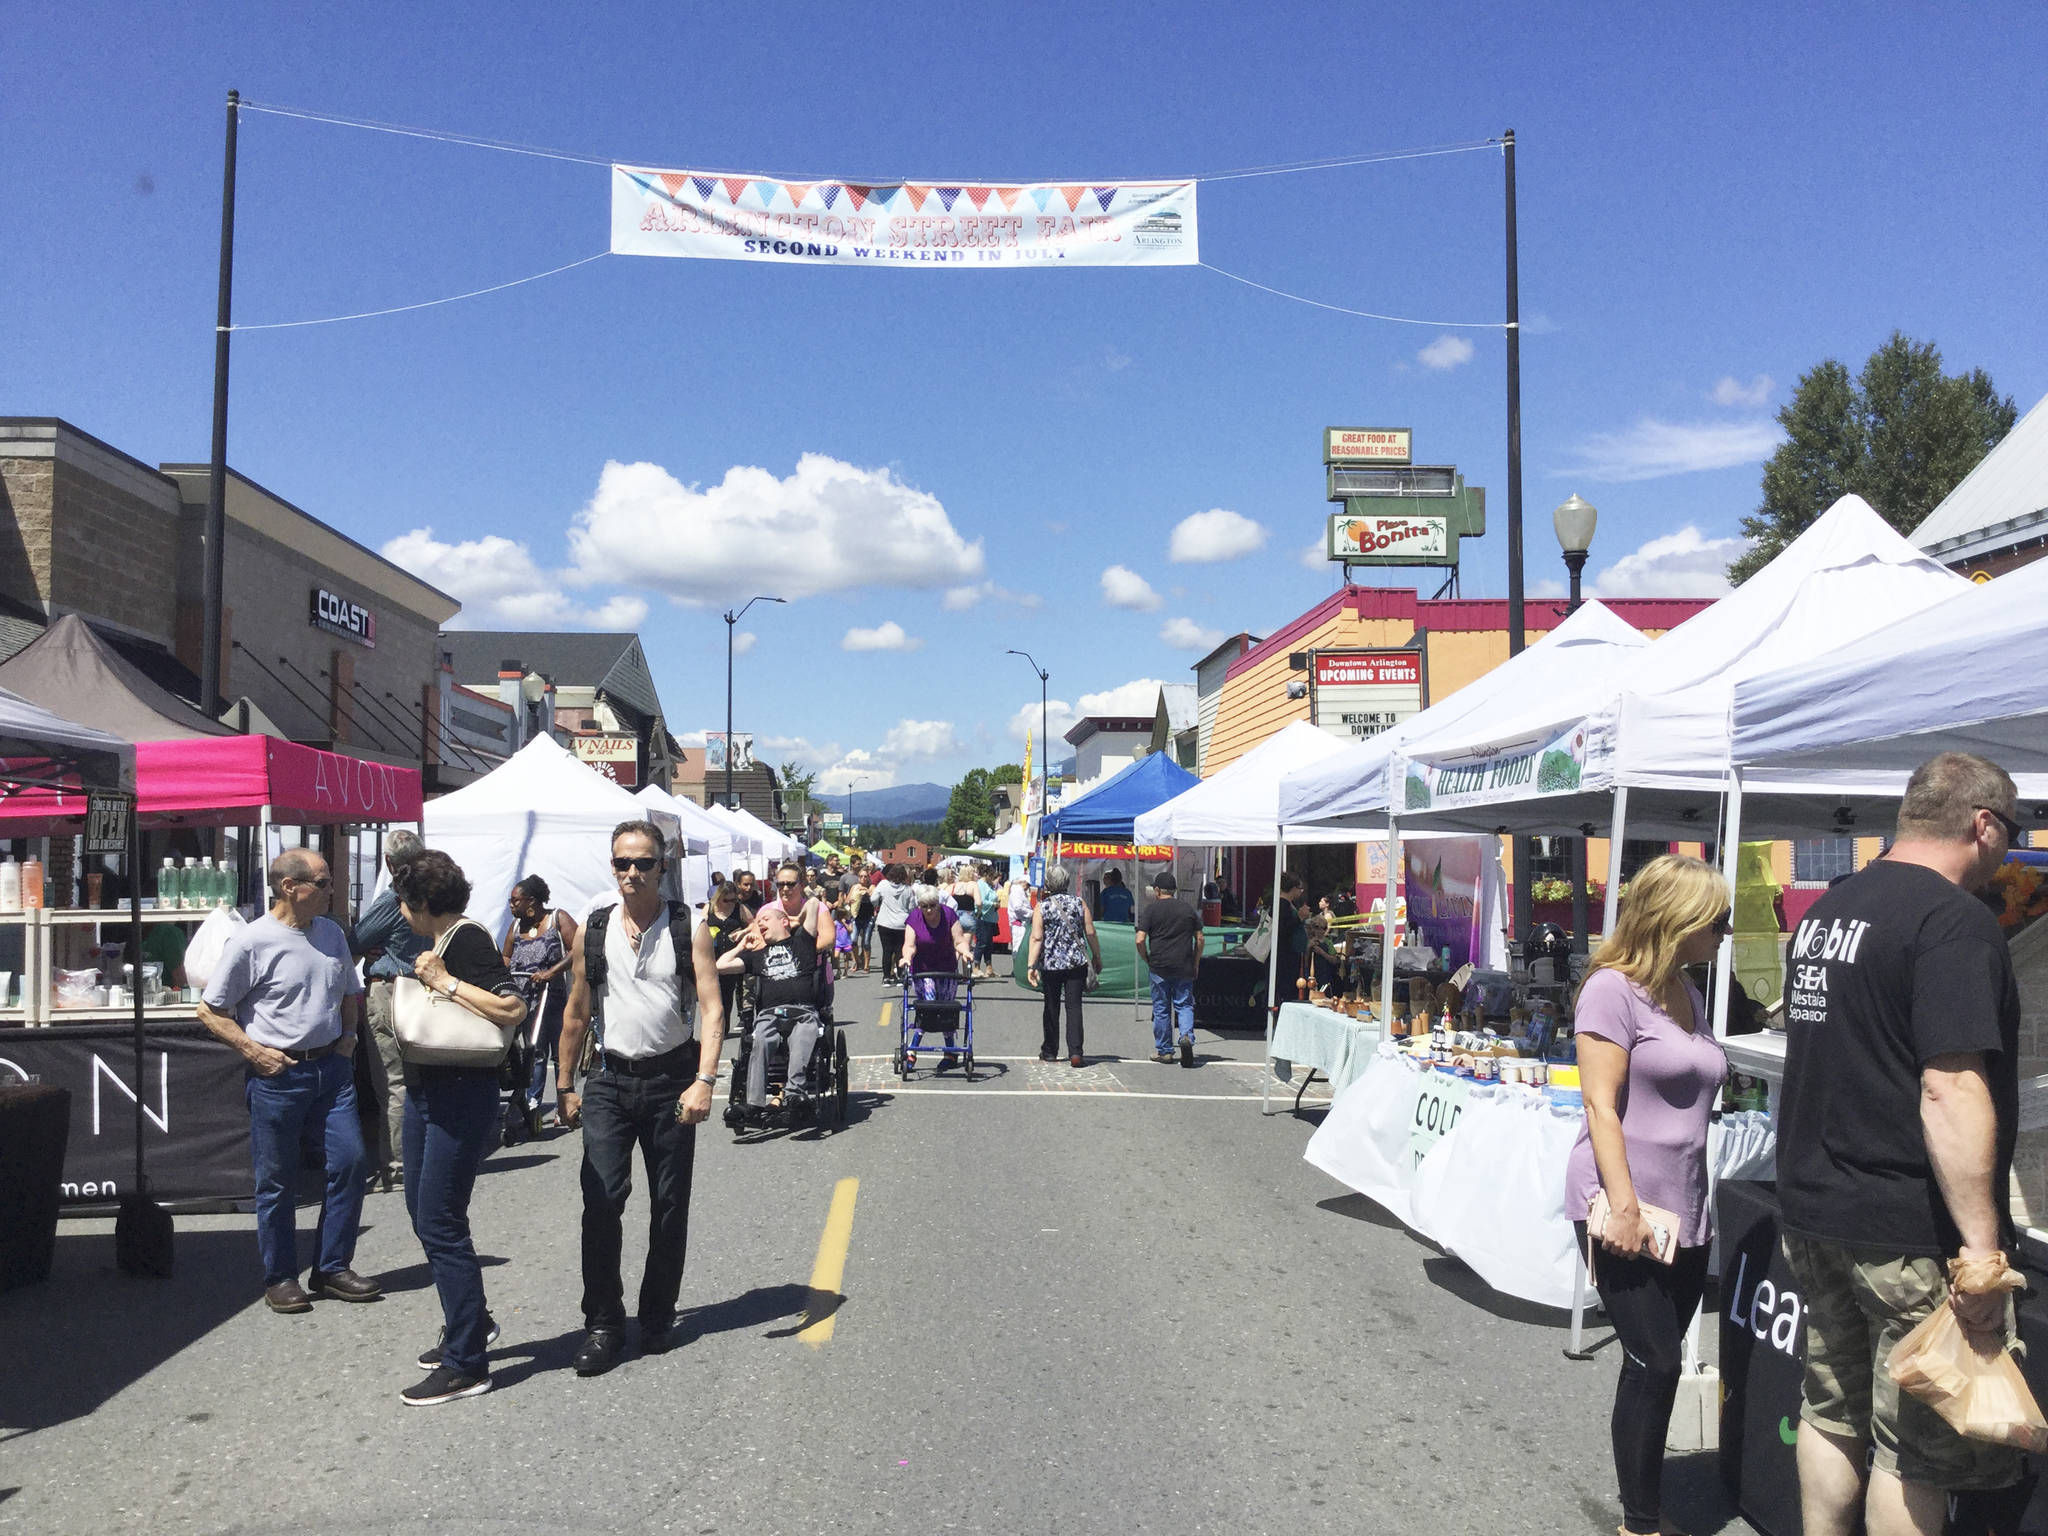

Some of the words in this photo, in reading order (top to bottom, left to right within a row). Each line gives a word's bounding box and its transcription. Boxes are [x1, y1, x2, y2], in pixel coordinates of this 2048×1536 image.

[640, 202, 877, 247] ARLINGTON
[888, 214, 1022, 248] STREET
[1036, 214, 1122, 243] FAIR
[1134, 234, 1183, 245] ARLINGTON
[744, 240, 839, 256] SECOND
[853, 247, 965, 262] WEEKEND
[978, 250, 1002, 262] IN
[1015, 247, 1066, 260] JULY
[1342, 434, 1365, 443] GREAT
[1367, 434, 1386, 443] FOOD
[1388, 435, 1396, 443] AT
[1332, 445, 1379, 455] REASONABLE
[1381, 446, 1407, 456] PRICES
[1377, 520, 1408, 531] Playa
[1360, 527, 1429, 553] Bonita
[319, 589, 368, 635] COAST
[1329, 659, 1367, 667] Downtown
[1370, 659, 1407, 667] Arlington
[1320, 669, 1374, 681] UPCOMING
[1380, 668, 1416, 681] EVENTS
[1342, 713, 1380, 724] WELCOME
[1385, 713, 1396, 722] TO
[1351, 724, 1396, 735] DOWNTO
[588, 738, 634, 750] NAILS
[1436, 762, 1487, 796] HEALTH
[1489, 752, 1537, 789] FOODS
[315, 753, 398, 813] AVON
[90, 810, 128, 839] OPEN
[1074, 843, 1118, 854] KETTLE
[1792, 918, 1865, 963] Mobil
[1793, 964, 1828, 991] GEA
[1730, 1252, 1808, 1356] Lea
